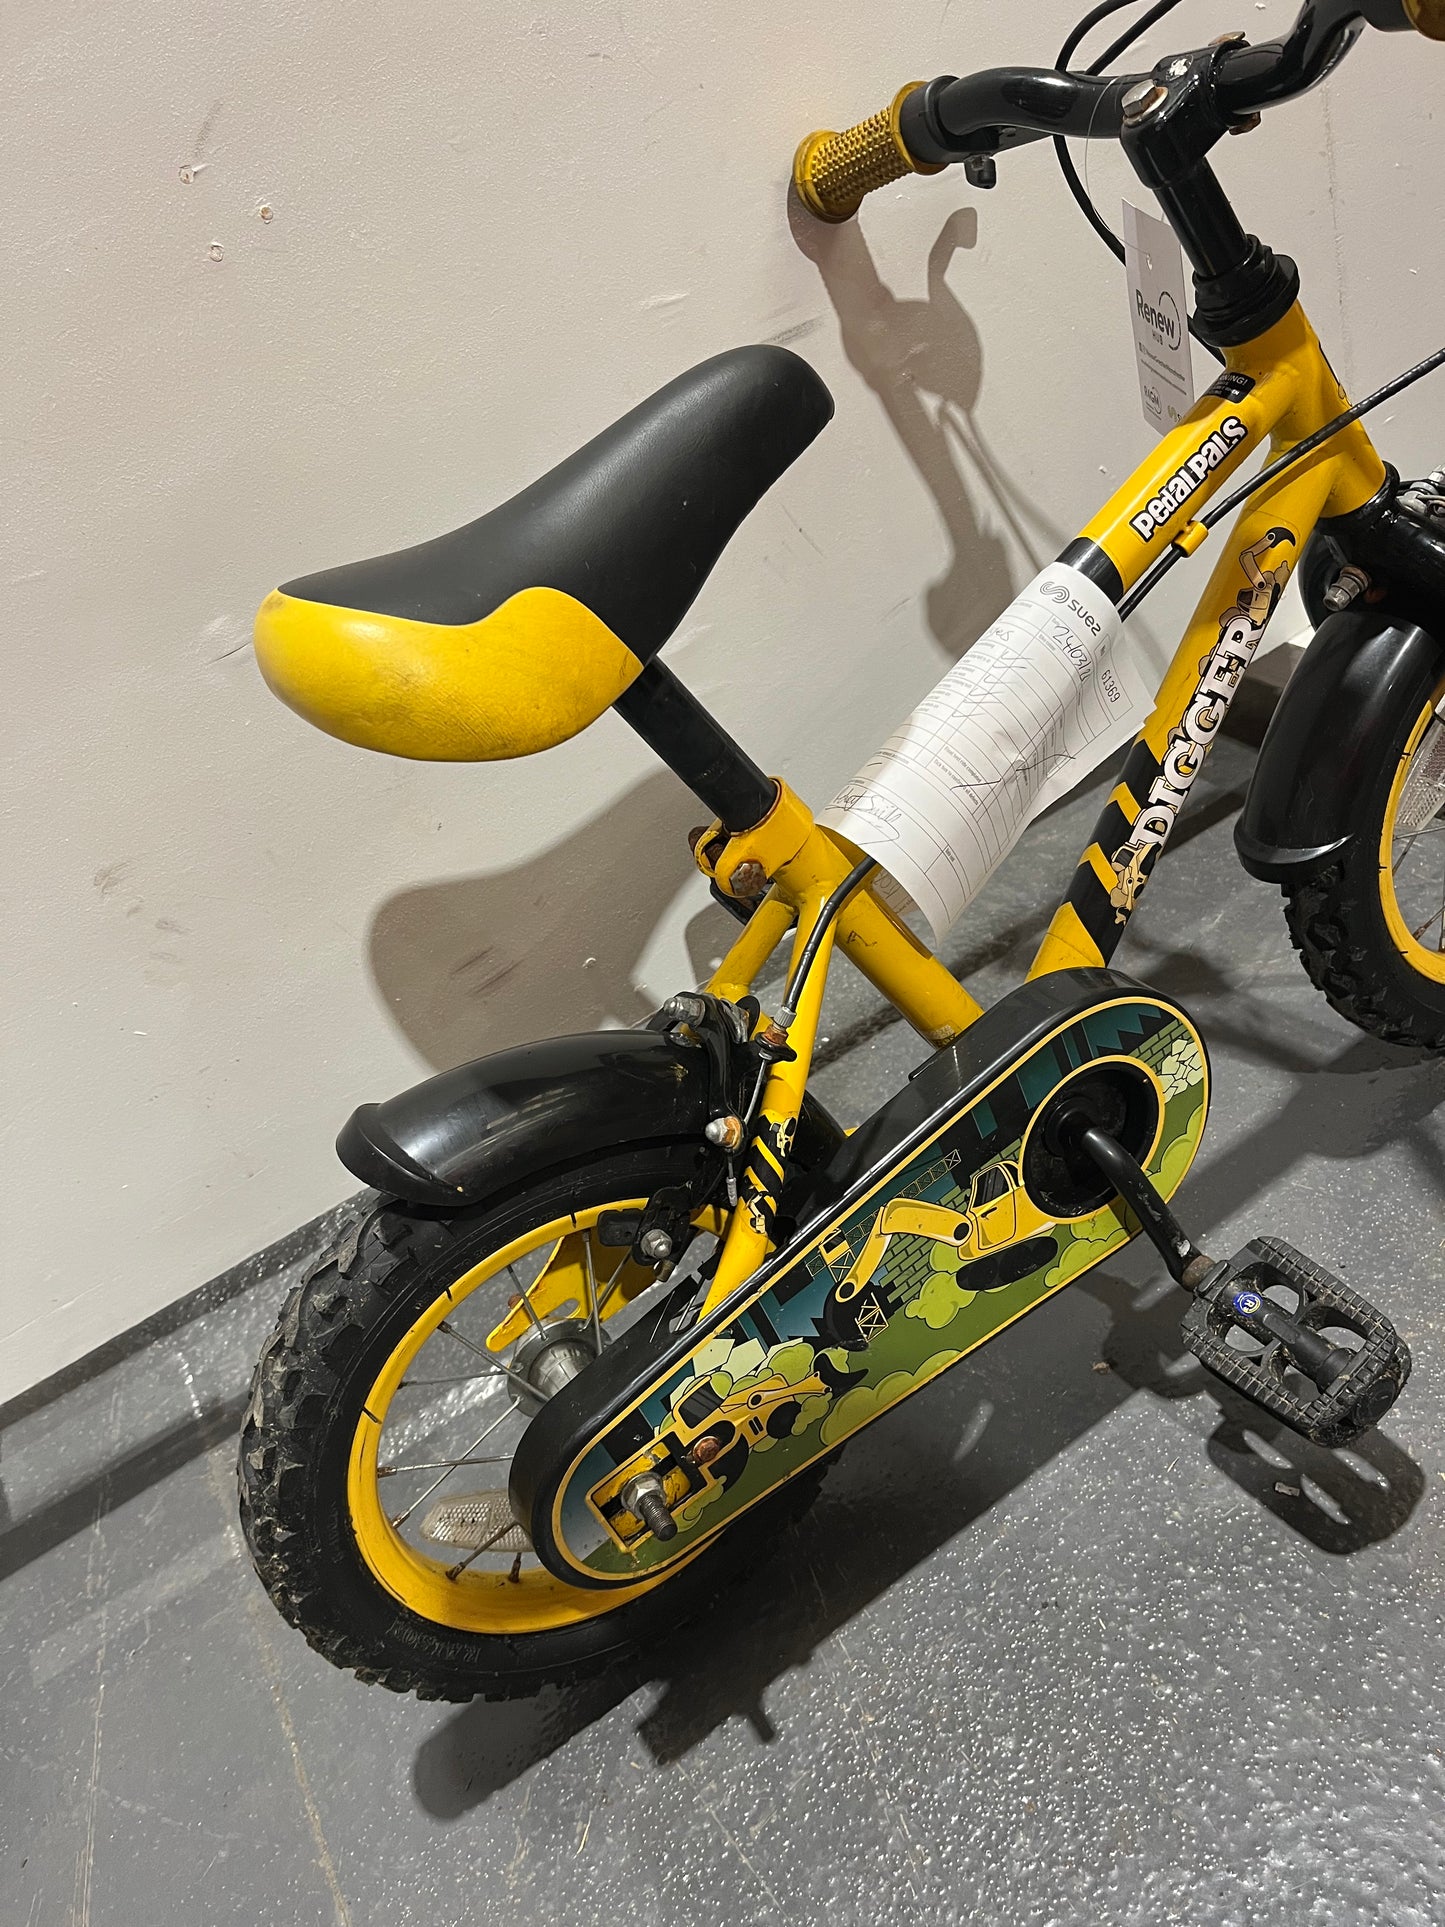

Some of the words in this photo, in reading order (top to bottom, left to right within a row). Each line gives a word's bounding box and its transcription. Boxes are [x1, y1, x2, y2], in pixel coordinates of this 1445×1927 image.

[1135, 288, 1175, 340] Renew
[1067, 599, 1101, 637] suez
[1100, 669, 1121, 703] 61369
[1129, 615, 1266, 850] DIGGER
